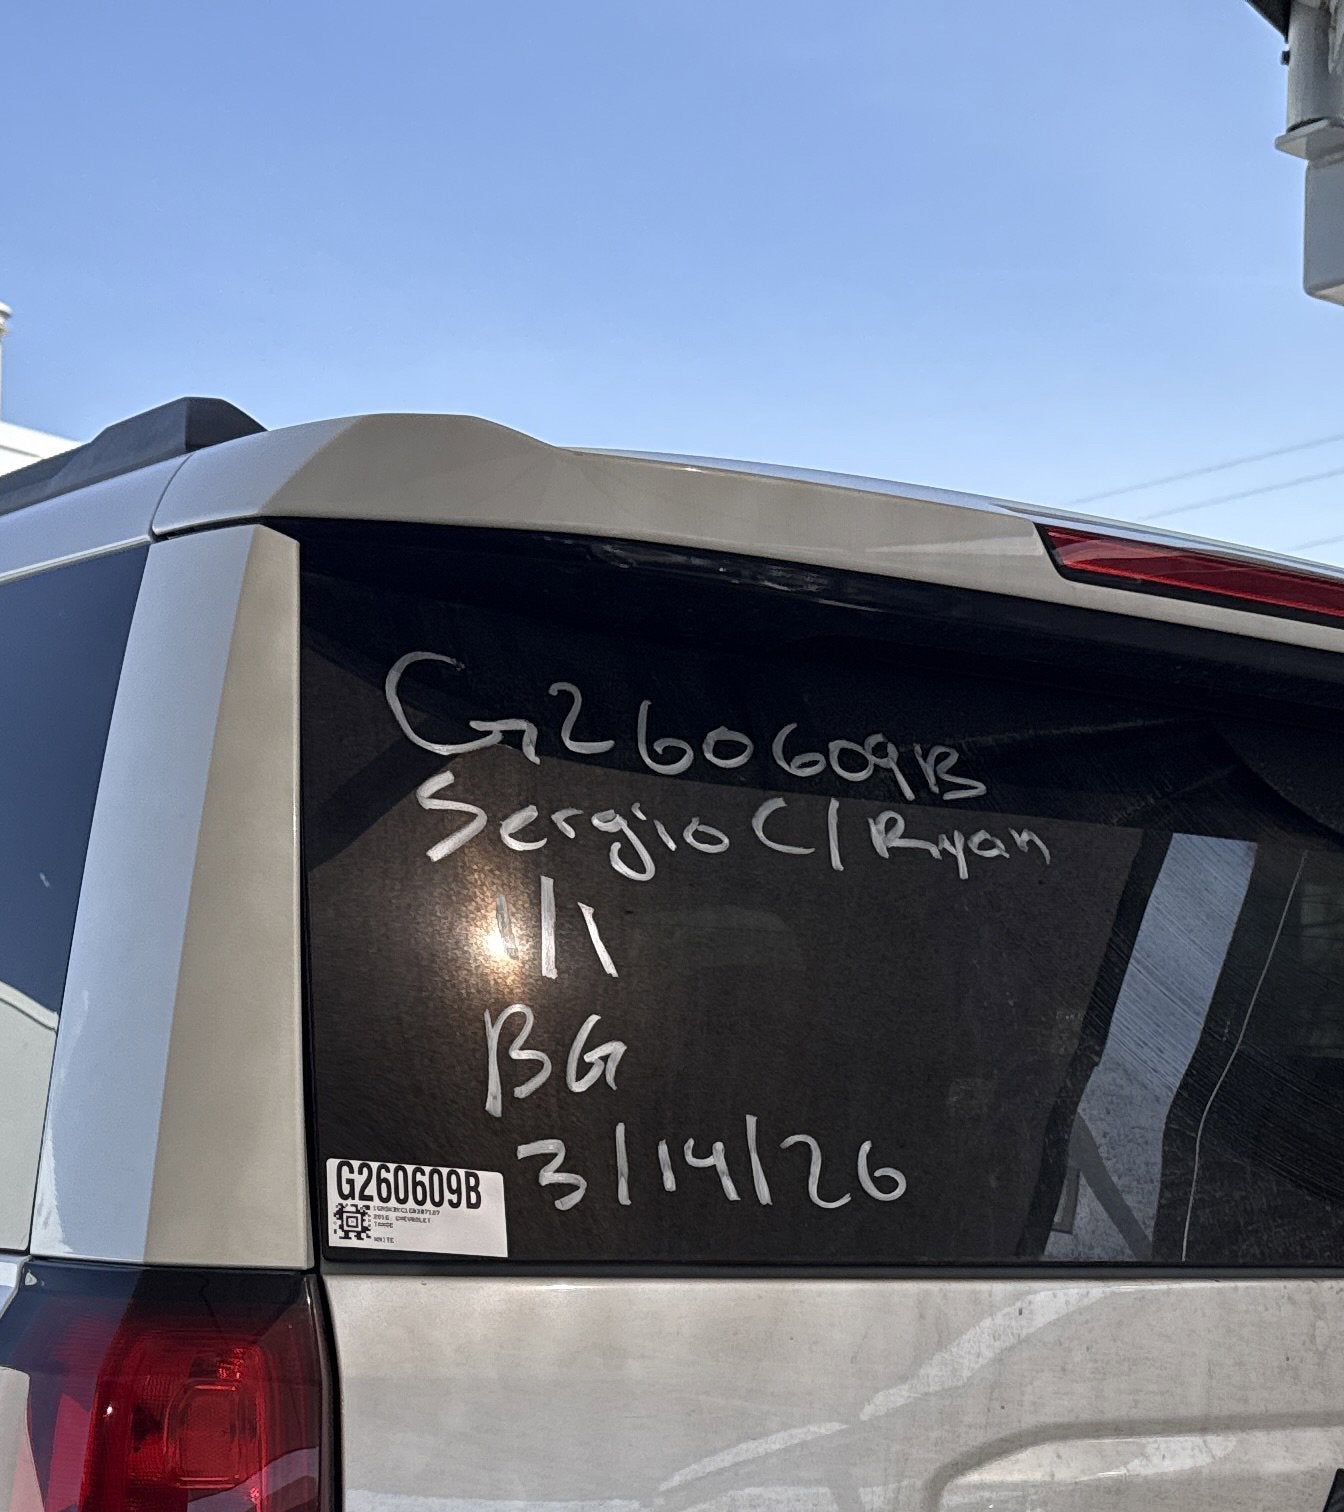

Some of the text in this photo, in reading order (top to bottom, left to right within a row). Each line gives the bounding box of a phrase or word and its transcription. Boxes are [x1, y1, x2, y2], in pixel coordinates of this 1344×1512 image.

[385, 651, 987, 801] G260609B
[417, 770, 730, 881] Sergio
[483, 1003, 628, 1117] BG
[336, 1160, 482, 1209] G260609B
